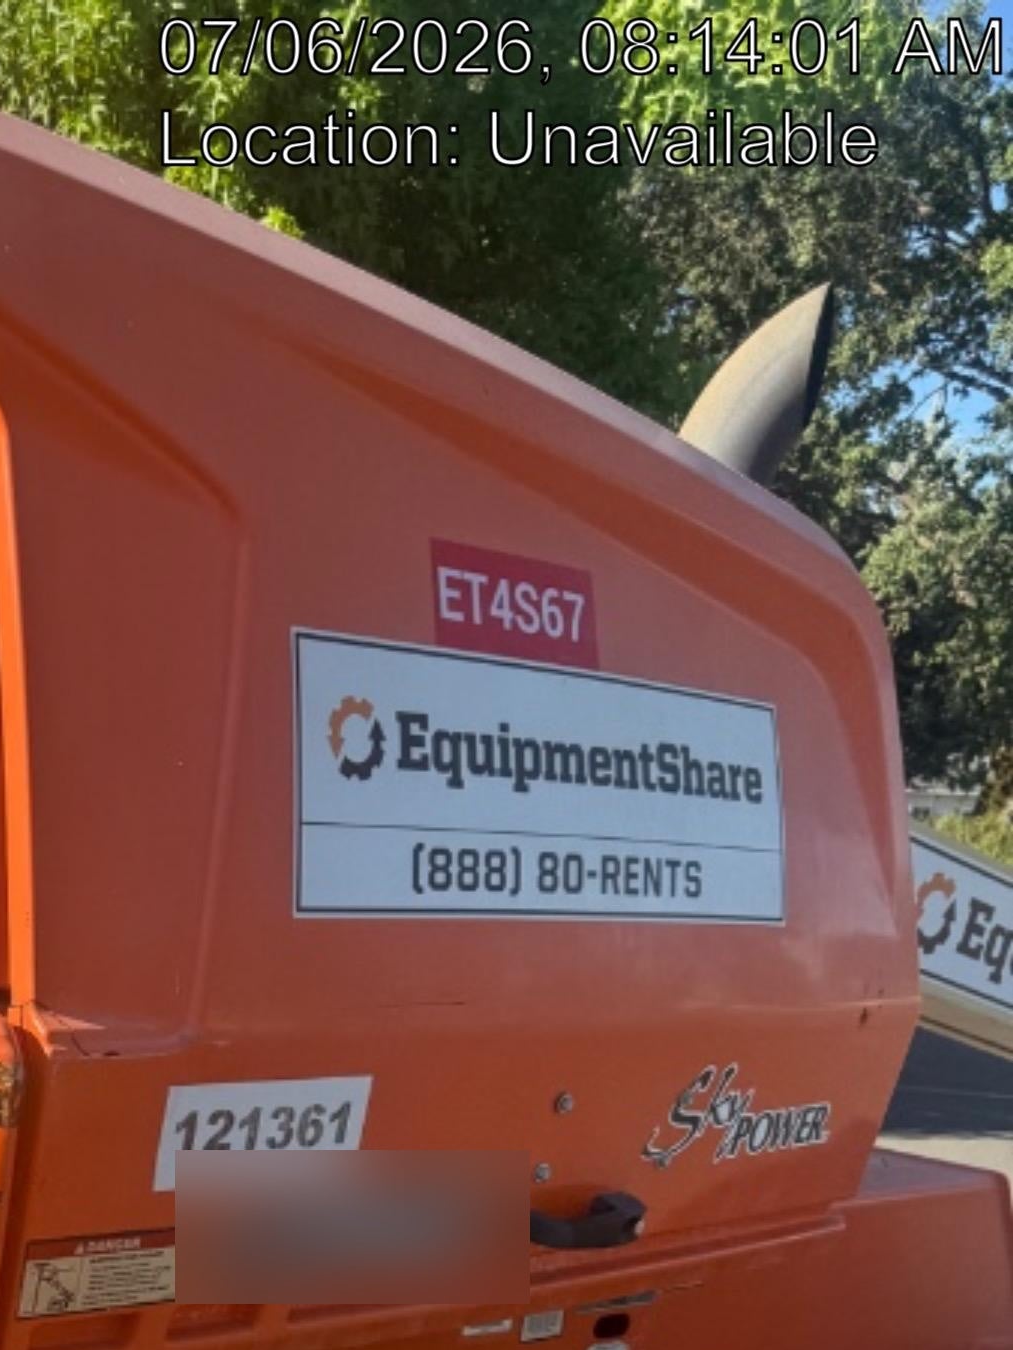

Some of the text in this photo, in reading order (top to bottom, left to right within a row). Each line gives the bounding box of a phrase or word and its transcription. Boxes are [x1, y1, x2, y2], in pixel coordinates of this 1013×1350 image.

[437, 565, 586, 643] ET4S67
[396, 711, 762, 804] EquipmentShare
[412, 842, 702, 899] (888) 80-RENTS
[955, 896, 1013, 985] Eq
[175, 1100, 352, 1151] 121361
[732, 1102, 831, 1156] POWER
